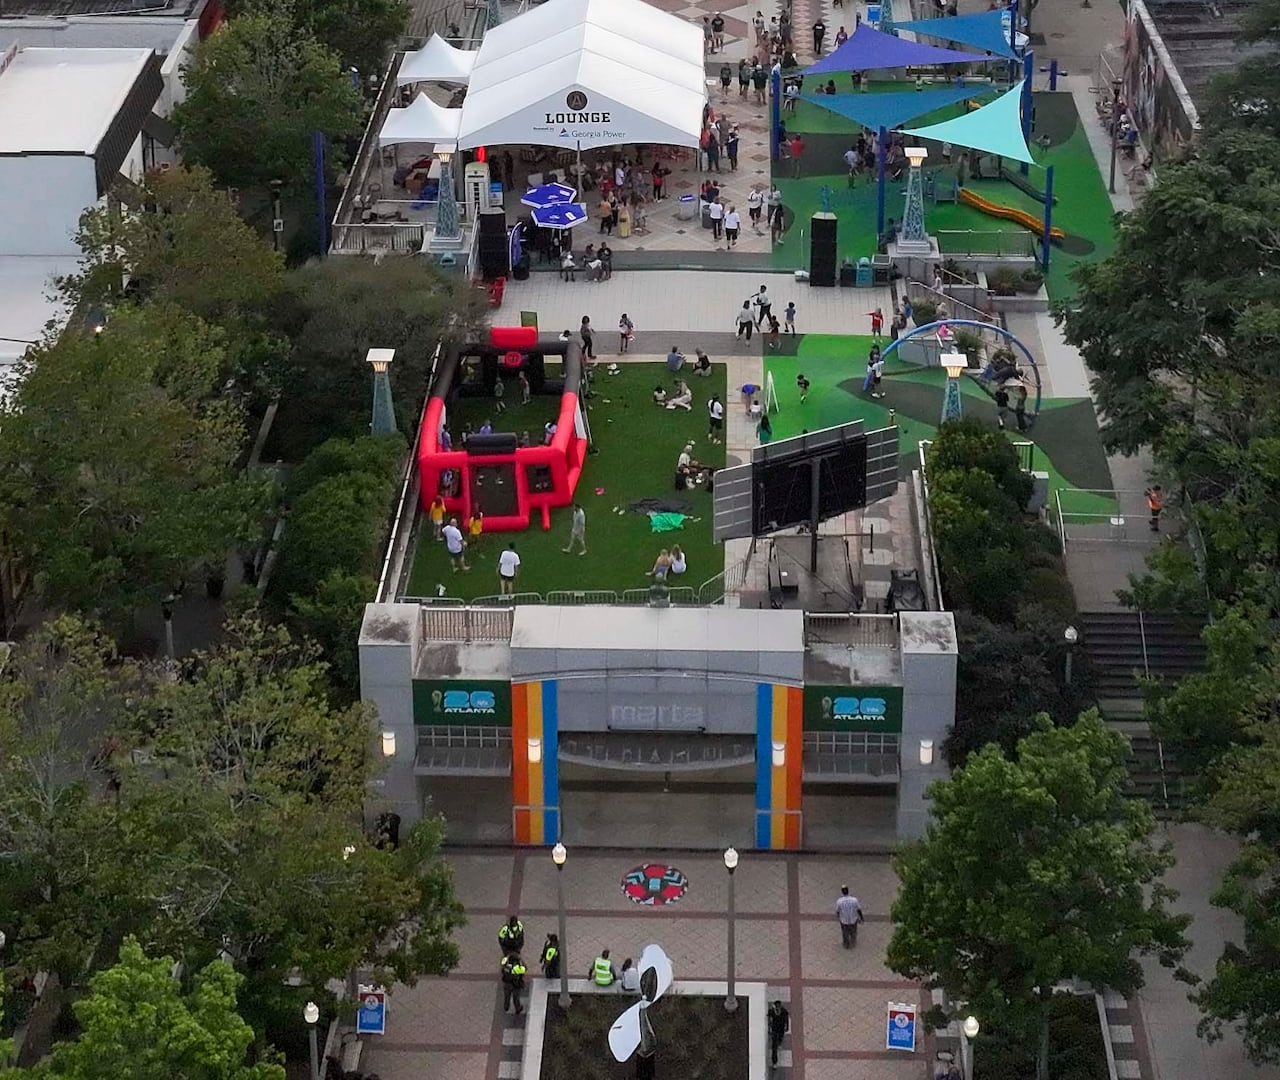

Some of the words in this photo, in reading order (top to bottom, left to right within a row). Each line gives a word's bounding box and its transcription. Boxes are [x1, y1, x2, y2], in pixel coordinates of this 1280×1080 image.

[545, 112, 611, 124] LOUNGE
[571, 130, 601, 138] Georgia
[444, 690, 495, 708] 26
[833, 697, 886, 715] 26
